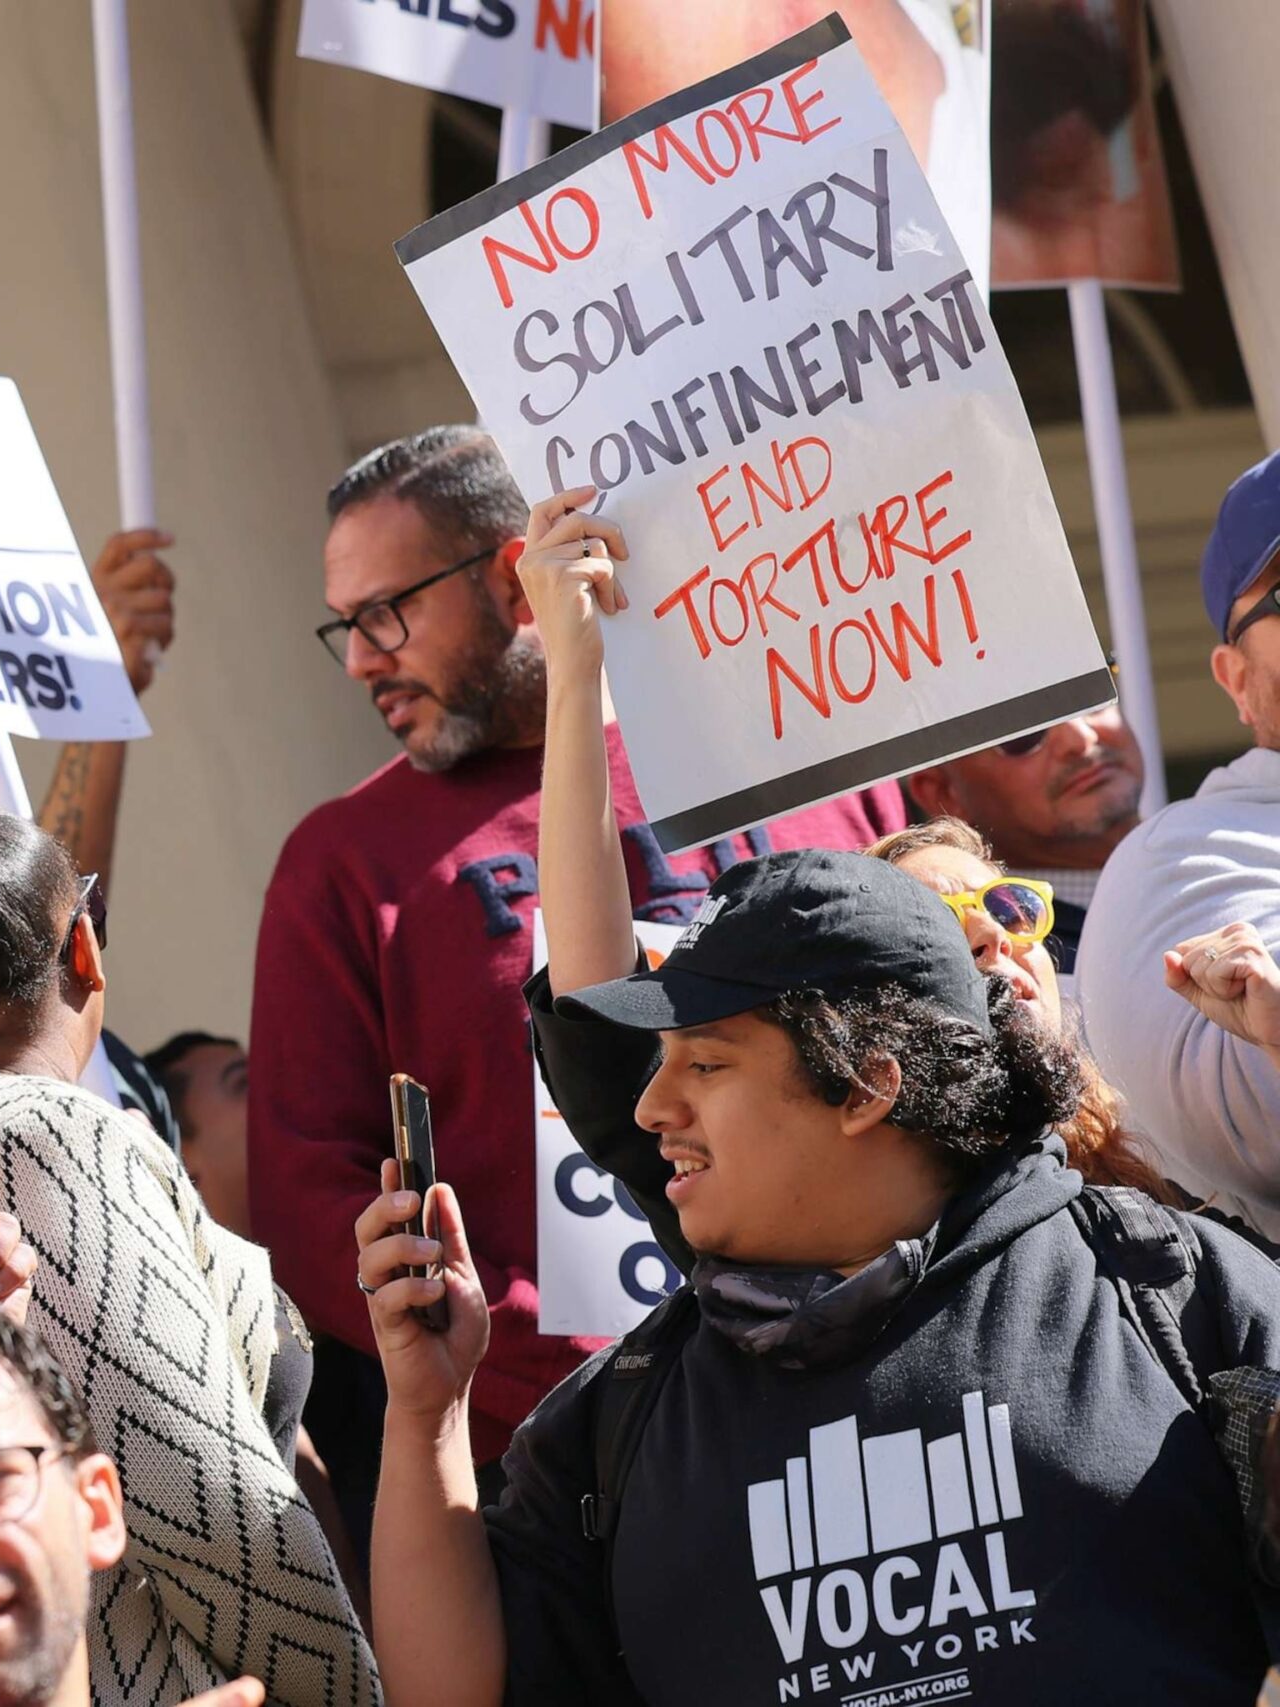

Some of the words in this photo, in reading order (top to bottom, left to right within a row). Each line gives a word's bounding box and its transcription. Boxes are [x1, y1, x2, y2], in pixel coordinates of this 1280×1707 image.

[483, 188, 599, 308] NO
[623, 57, 842, 219] MORE
[514, 148, 894, 425] SOLITARY
[546, 269, 987, 515] CONFINEMENT
[654, 471, 972, 660] TORTURE
[697, 436, 832, 551] END
[766, 570, 986, 740] NOW!
[759, 1531, 1037, 1664] VOCAL
[778, 1651, 876, 1703] NEW
[900, 1617, 1037, 1668] YORK
